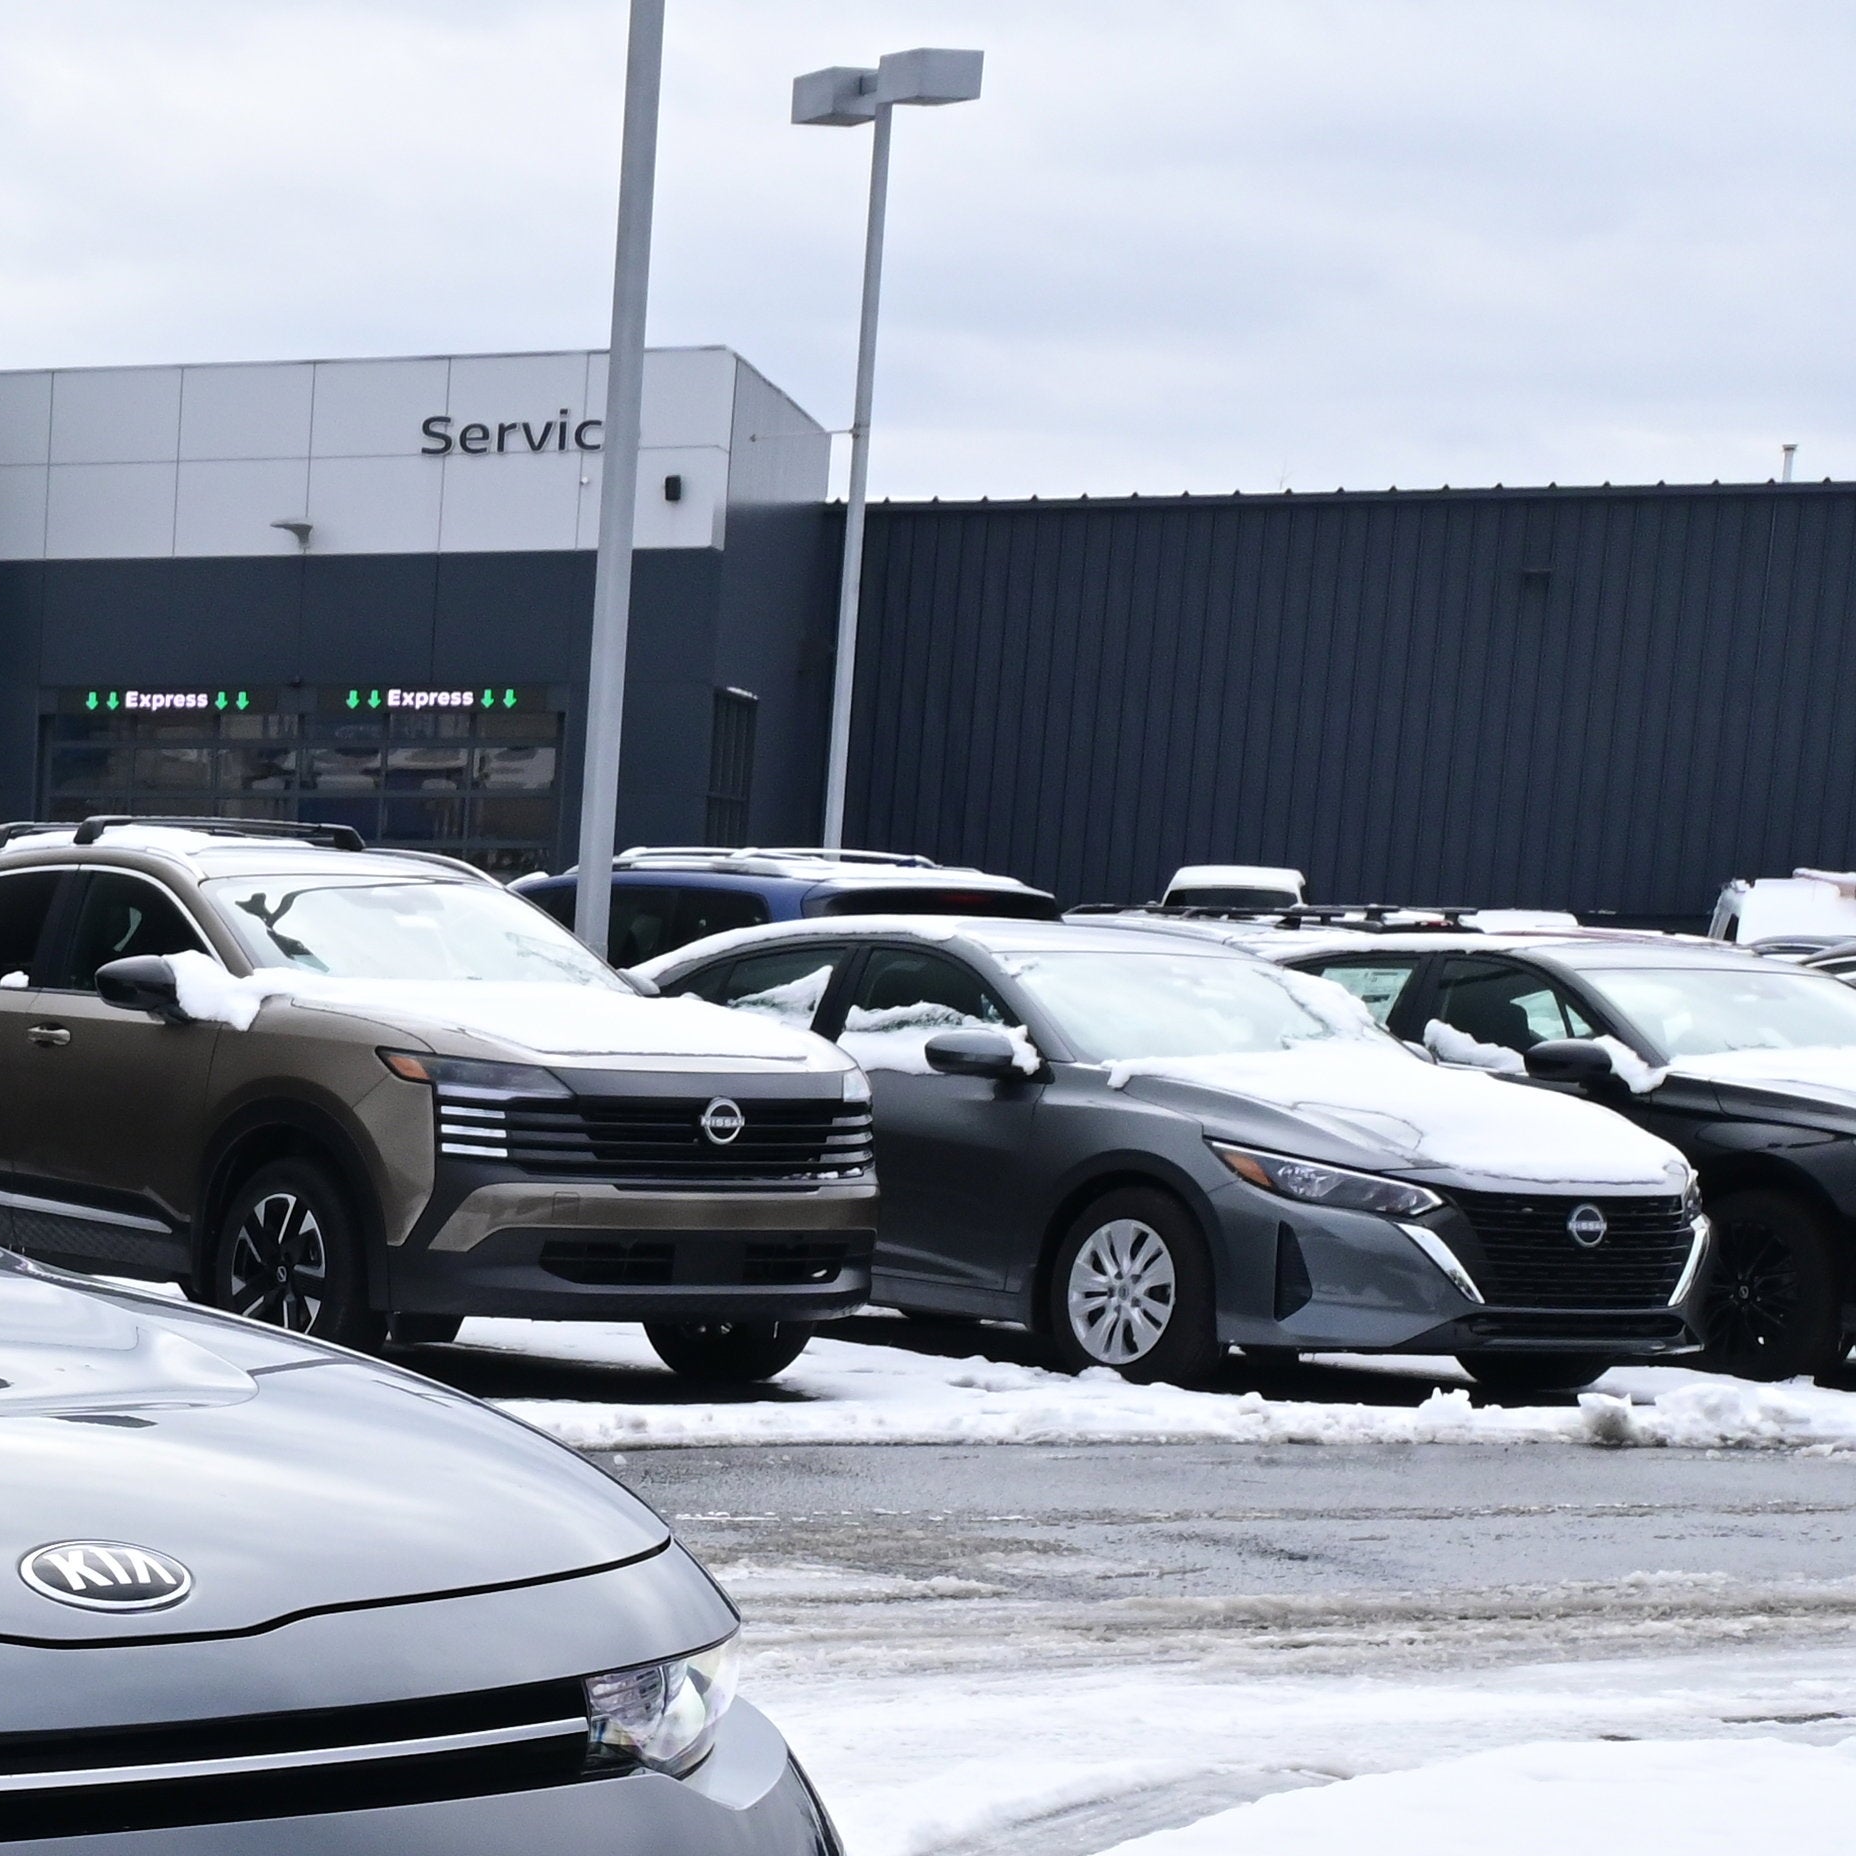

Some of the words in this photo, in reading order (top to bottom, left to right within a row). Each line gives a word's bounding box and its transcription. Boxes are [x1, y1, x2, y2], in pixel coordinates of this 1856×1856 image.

[421, 408, 604, 455] Servic
[124, 691, 209, 711] Express
[387, 689, 475, 710] Express
[43, 1549, 176, 1590] KIA
